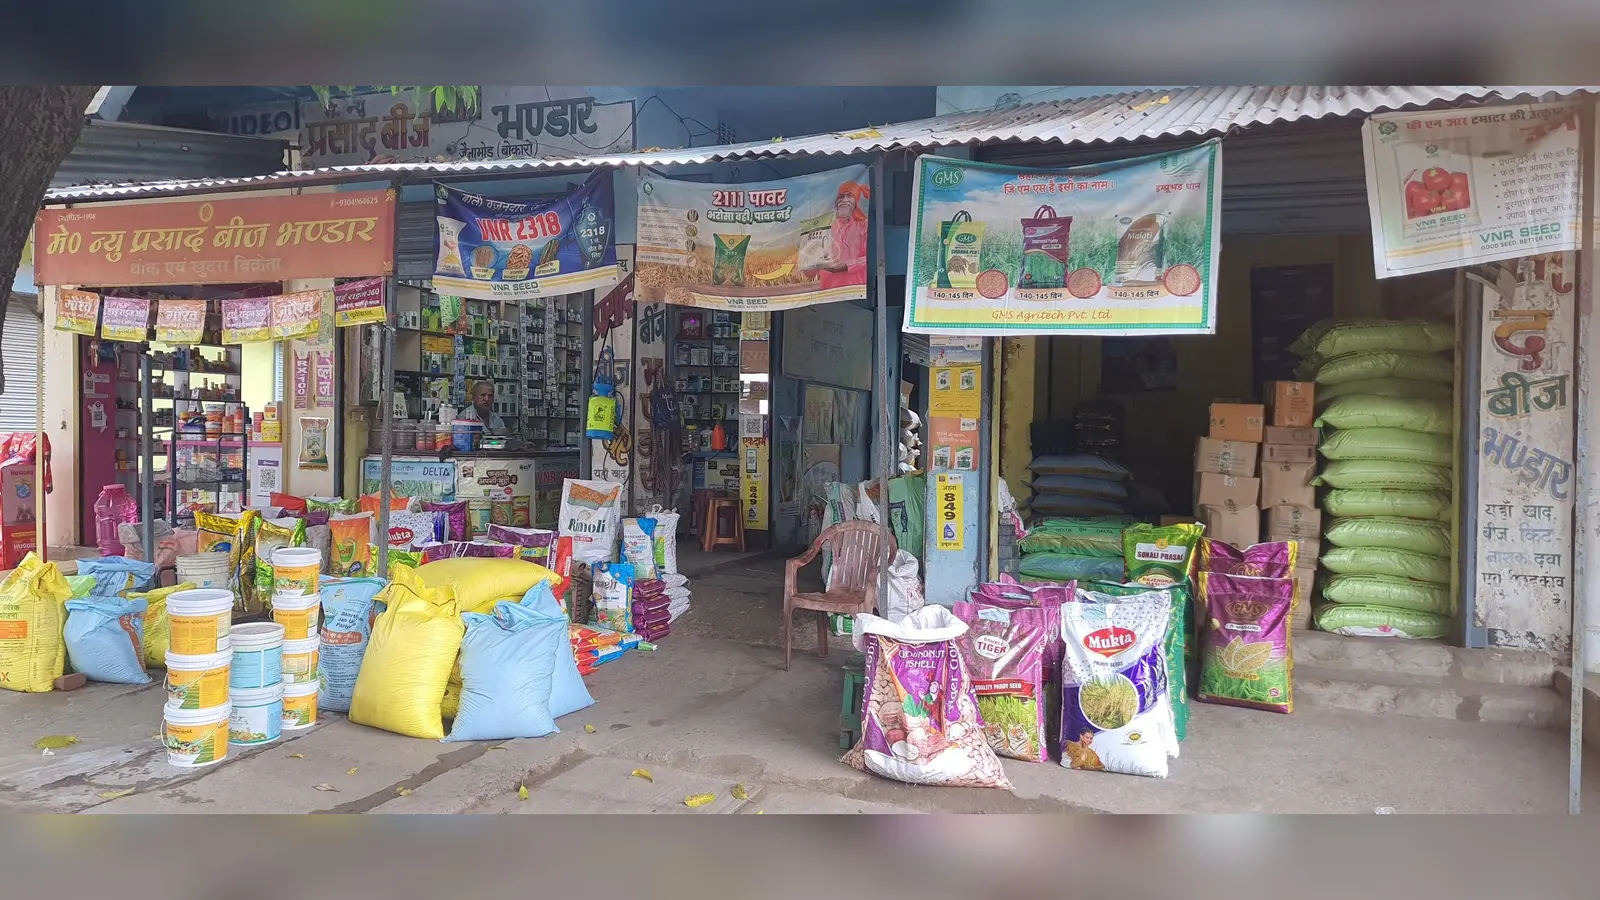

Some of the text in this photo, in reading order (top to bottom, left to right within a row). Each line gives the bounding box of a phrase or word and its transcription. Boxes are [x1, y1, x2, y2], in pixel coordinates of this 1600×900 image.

[1446, 117, 1469, 127] आर
[1471, 113, 1506, 125] टमाटर
[1509, 109, 1526, 121] की
[303, 116, 379, 163] प्रसाद
[491, 96, 598, 140] भण्डार
[935, 168, 960, 185] GMS
[1017, 183, 1031, 196] एम
[1033, 183, 1047, 196] एस
[1048, 180, 1056, 194] है
[1057, 180, 1073, 193] इसी
[1076, 182, 1089, 193] का
[1186, 182, 1201, 190] धान
[712, 188, 788, 208] 2111 पावर
[706, 208, 734, 222] भरोसा
[754, 210, 776, 222] पावर
[776, 206, 793, 221] नई
[1415, 212, 1467, 228] VNR SEED
[476, 210, 562, 242] VNR 2318
[581, 225, 606, 238] 2318
[1479, 229, 1514, 243] VNR
[1519, 222, 1562, 237] SEED
[88, 230, 127, 263] न्यु
[130, 226, 208, 254] प्रसाद
[213, 215, 270, 249] बीज
[275, 216, 379, 247] भण्डार
[957, 234, 975, 242] GMS
[1127, 231, 1153, 240] Malati
[1480, 232, 1562, 250] GOOD SEED BETTER YIELD
[366, 288, 380, 297] 360
[490, 280, 539, 291] VNR SEED
[1146, 289, 1159, 297] दिन
[1050, 291, 1062, 299] दिन
[991, 309, 1113, 322] GMS Agritech Pvt. Ltd.
[1484, 371, 1570, 421] बीज
[1481, 425, 1573, 501] भण्डार
[422, 466, 451, 477] DELTA
[1137, 551, 1159, 559] SONALI
[1534, 552, 1561, 568] दवा
[1232, 602, 1261, 615] GMS
[977, 641, 1007, 654] TIGER
[1088, 632, 1133, 649] Mukta
